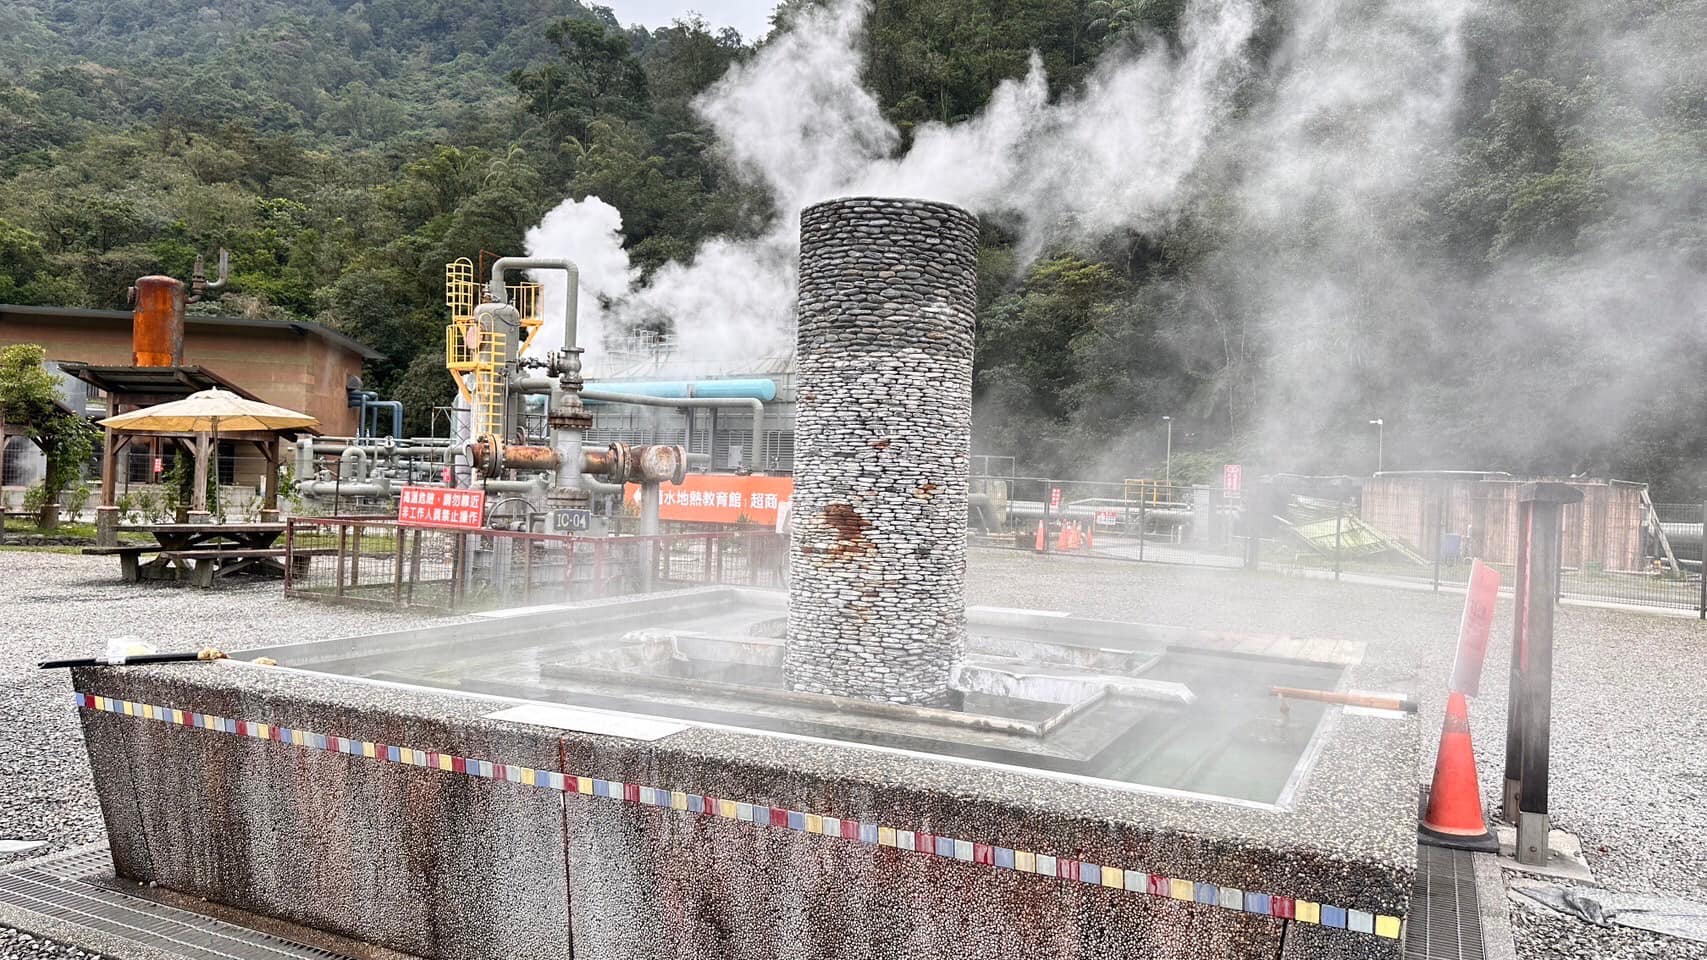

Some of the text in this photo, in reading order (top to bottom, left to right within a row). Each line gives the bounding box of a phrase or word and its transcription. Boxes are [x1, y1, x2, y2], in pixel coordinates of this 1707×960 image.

[659, 488, 778, 509] 水地熱教育館 超商
